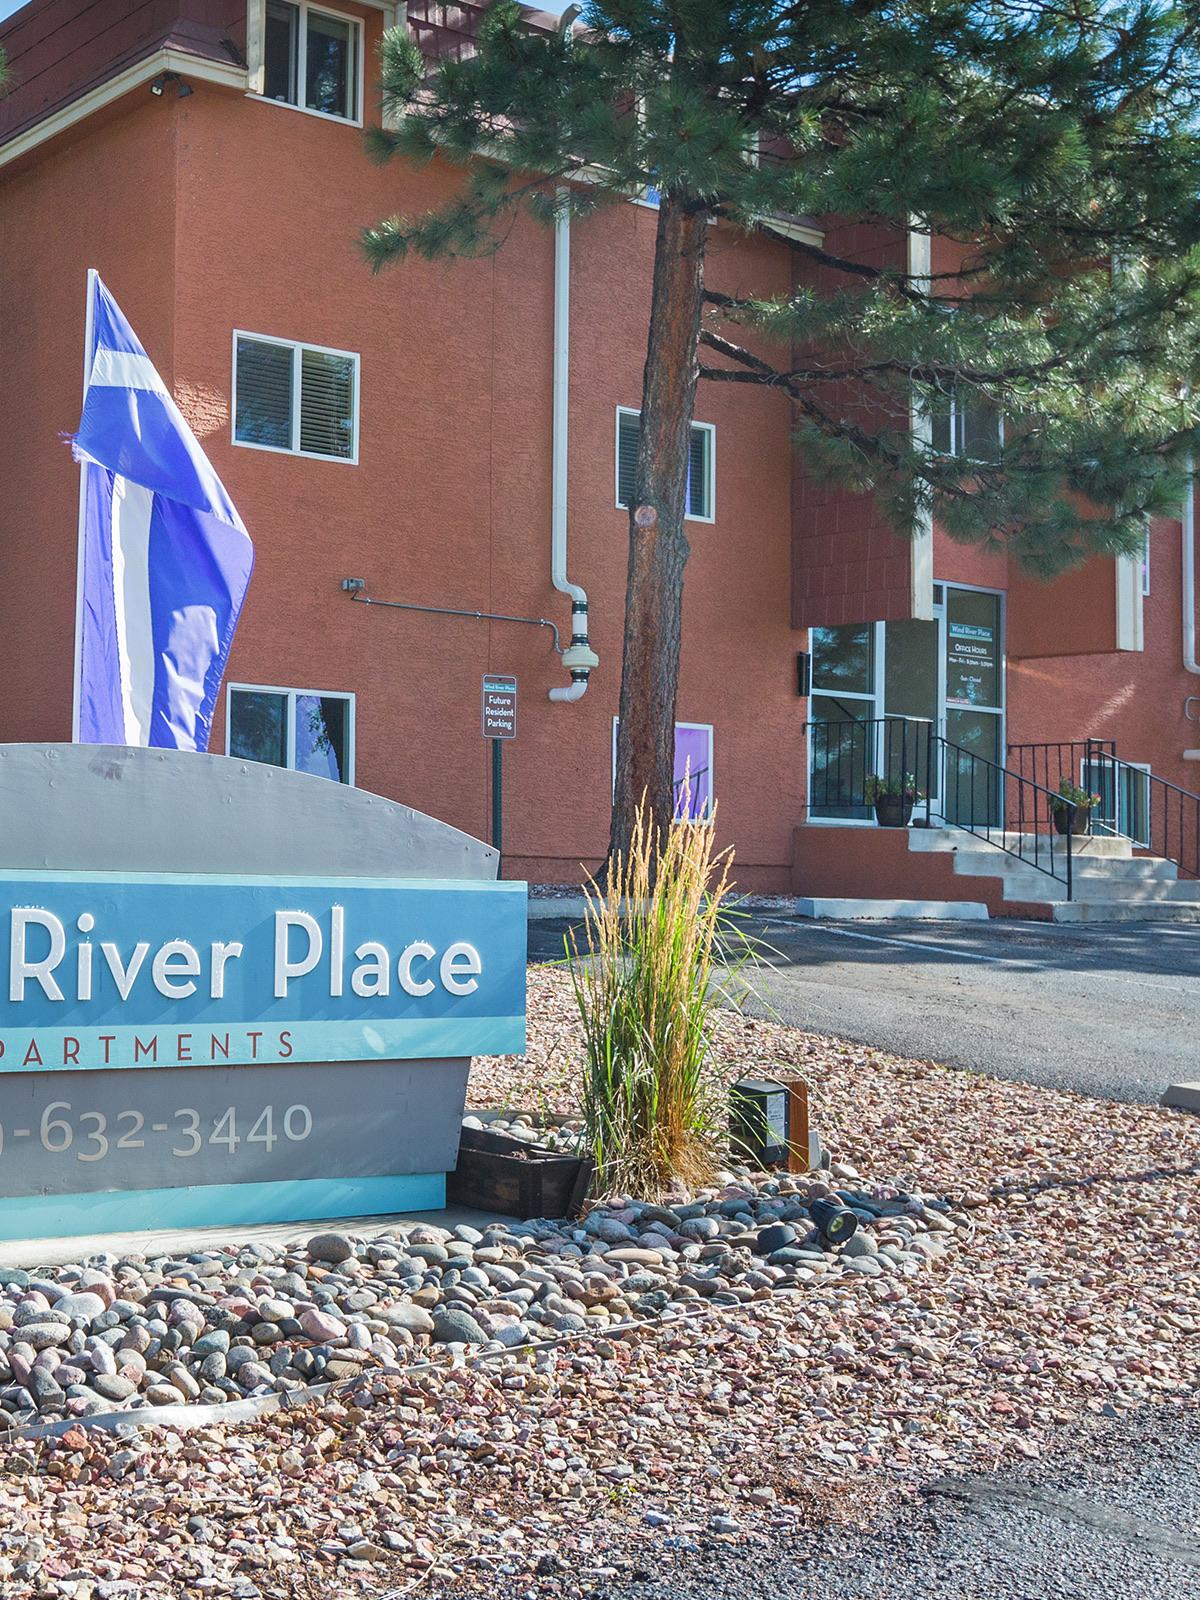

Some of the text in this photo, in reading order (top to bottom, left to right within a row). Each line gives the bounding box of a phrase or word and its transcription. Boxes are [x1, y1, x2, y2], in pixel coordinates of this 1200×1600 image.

[955, 643, 987, 655] OFFICE HOURS
[488, 695, 511, 705] Future
[485, 706, 514, 717] Resident
[487, 718, 512, 730] Parking
[8, 908, 244, 1003] River
[273, 904, 482, 999] Place
